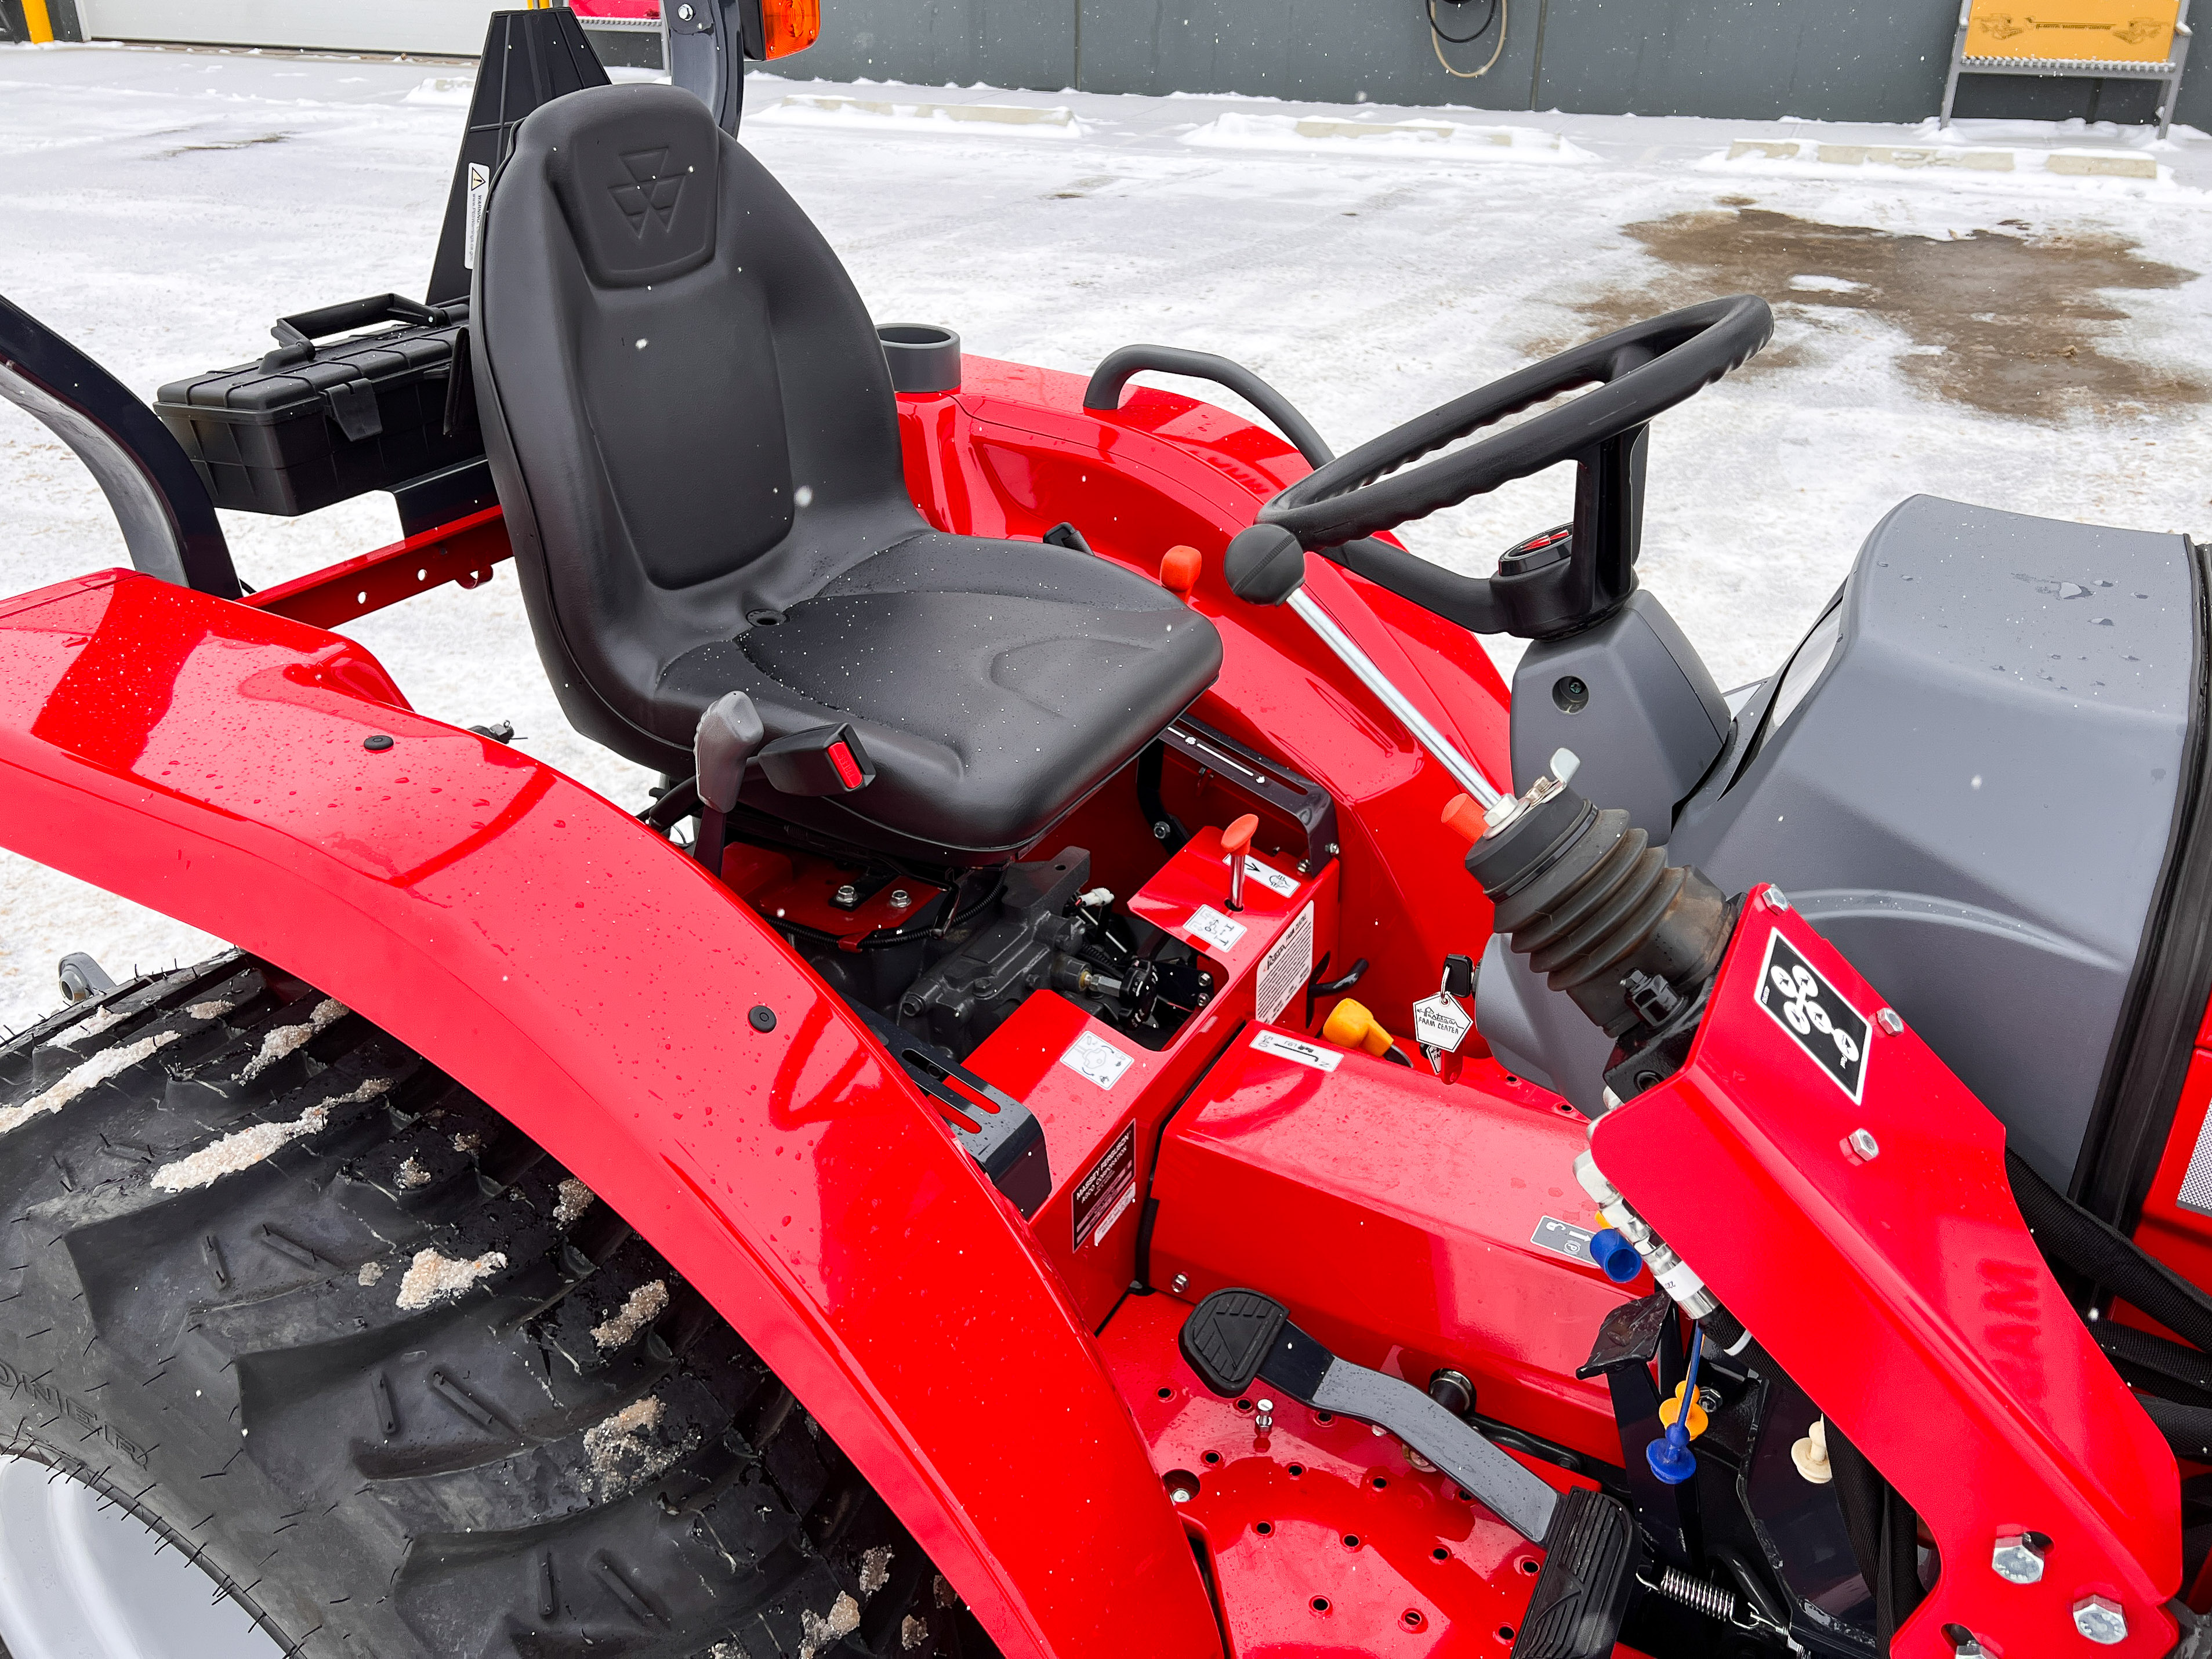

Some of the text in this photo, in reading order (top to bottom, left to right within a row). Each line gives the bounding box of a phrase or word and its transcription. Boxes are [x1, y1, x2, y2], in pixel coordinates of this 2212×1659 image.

[1076, 1167, 1100, 1200] MASSEY
[1100, 1132, 1129, 1171] FERGUSON
[1096, 1145, 1127, 1185] CORPORATION
